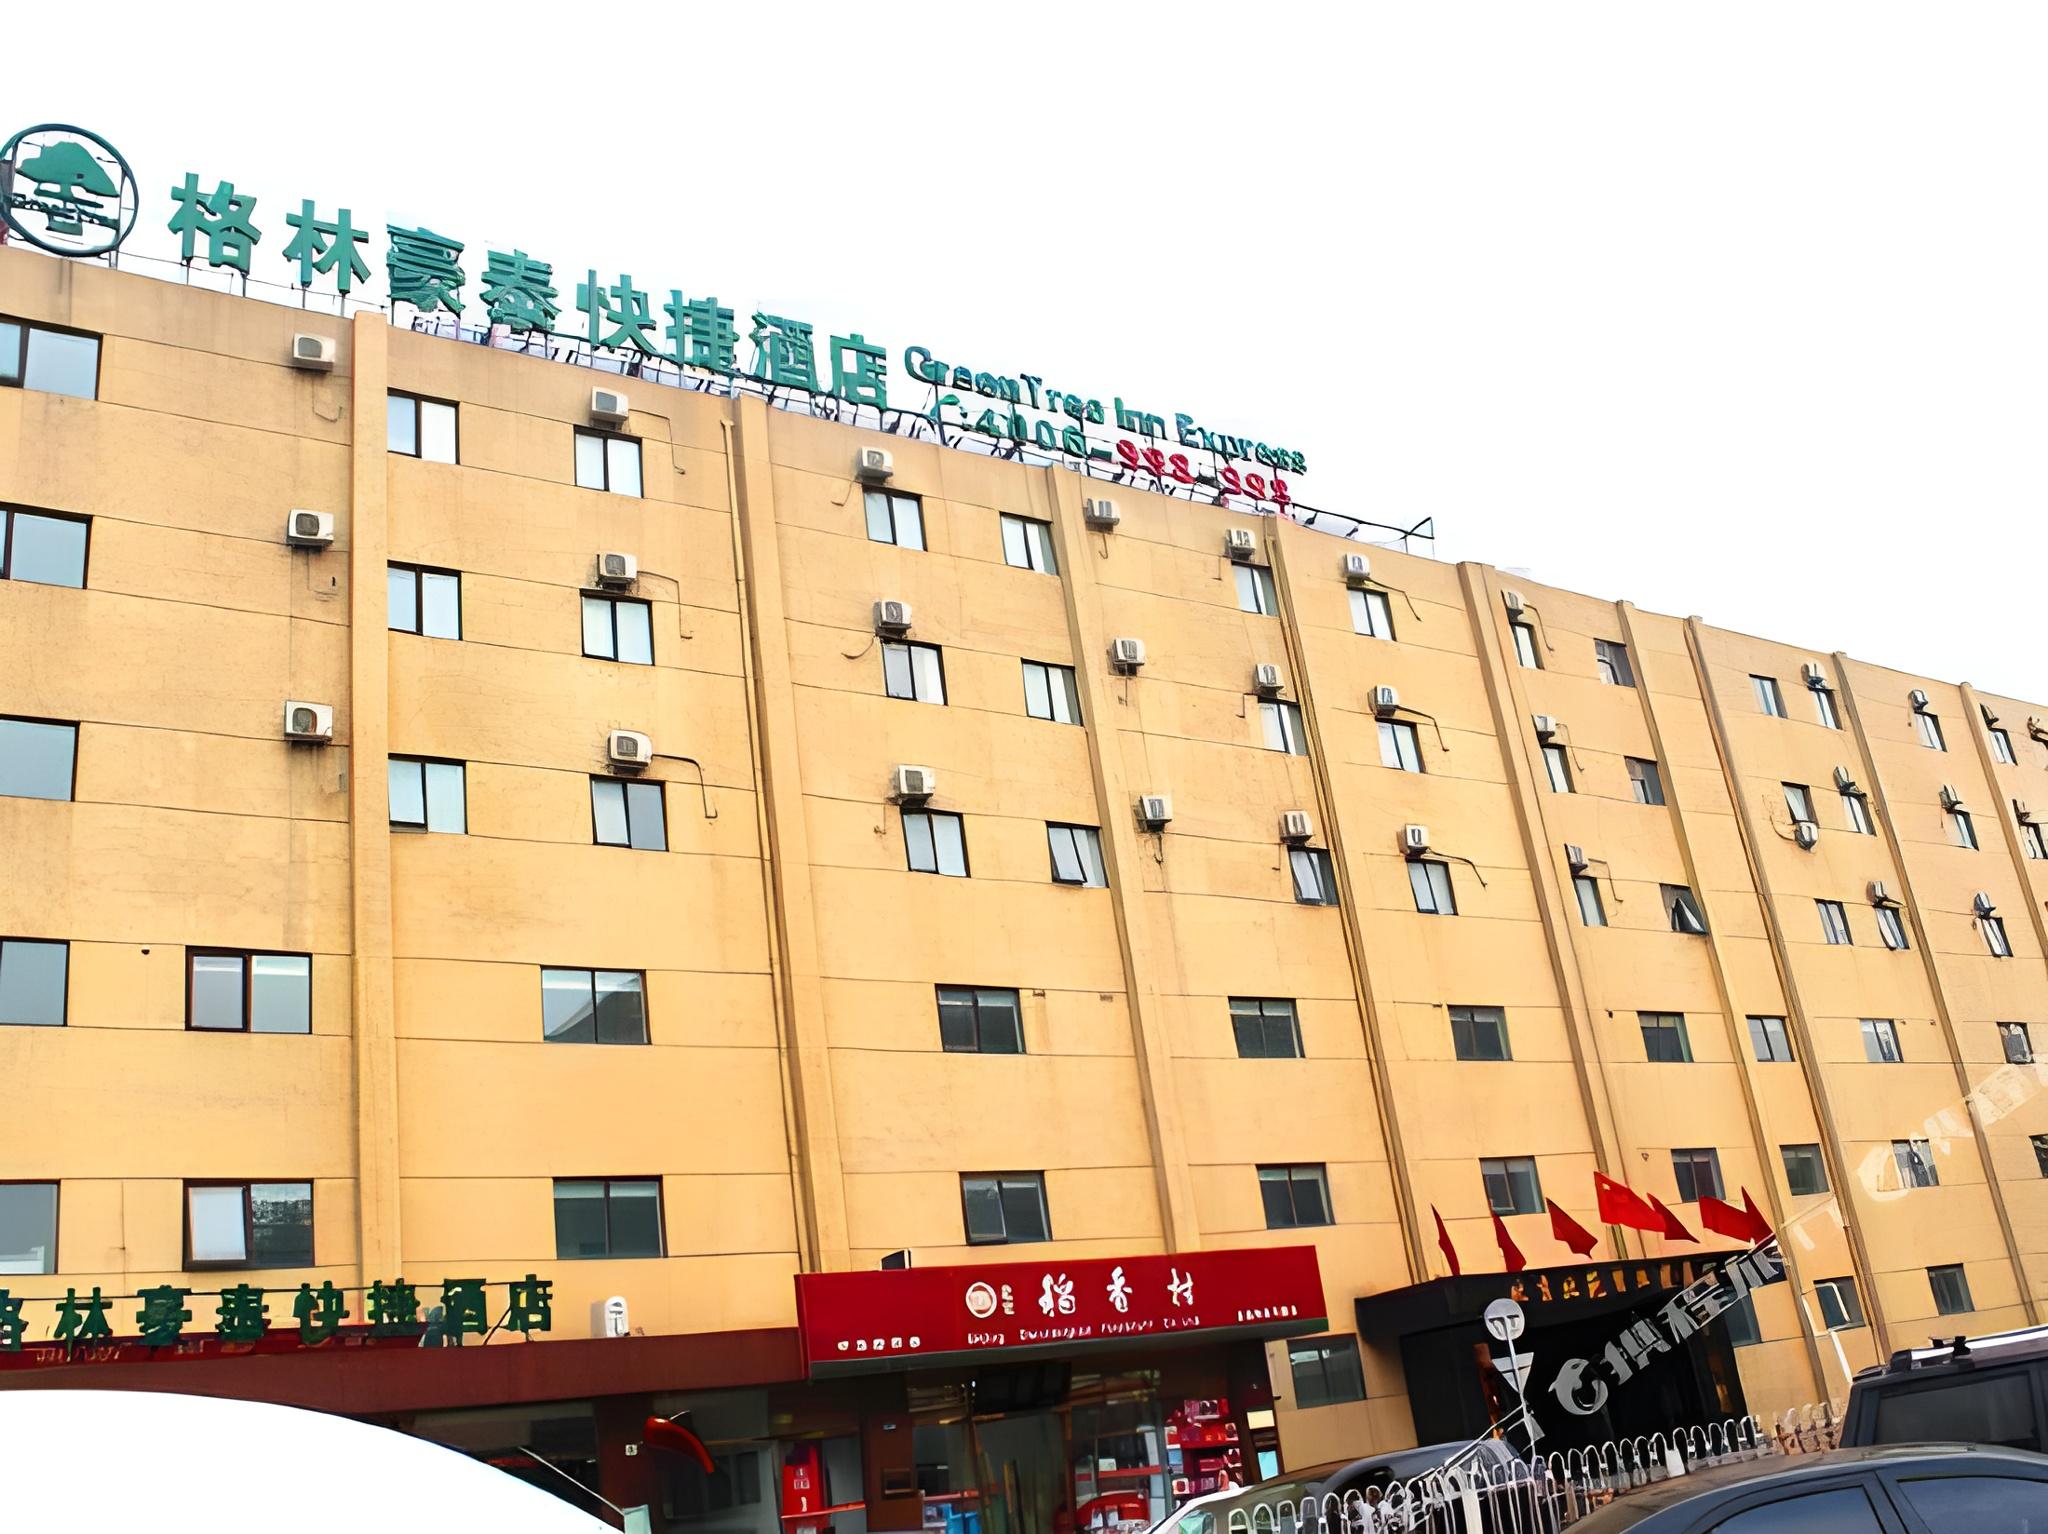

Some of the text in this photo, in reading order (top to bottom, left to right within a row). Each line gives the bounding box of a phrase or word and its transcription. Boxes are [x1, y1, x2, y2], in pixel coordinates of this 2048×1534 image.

[167, 172, 888, 411] 格林豪泰快捷酒店
[1038, 1265, 1194, 1318] 稻香村
